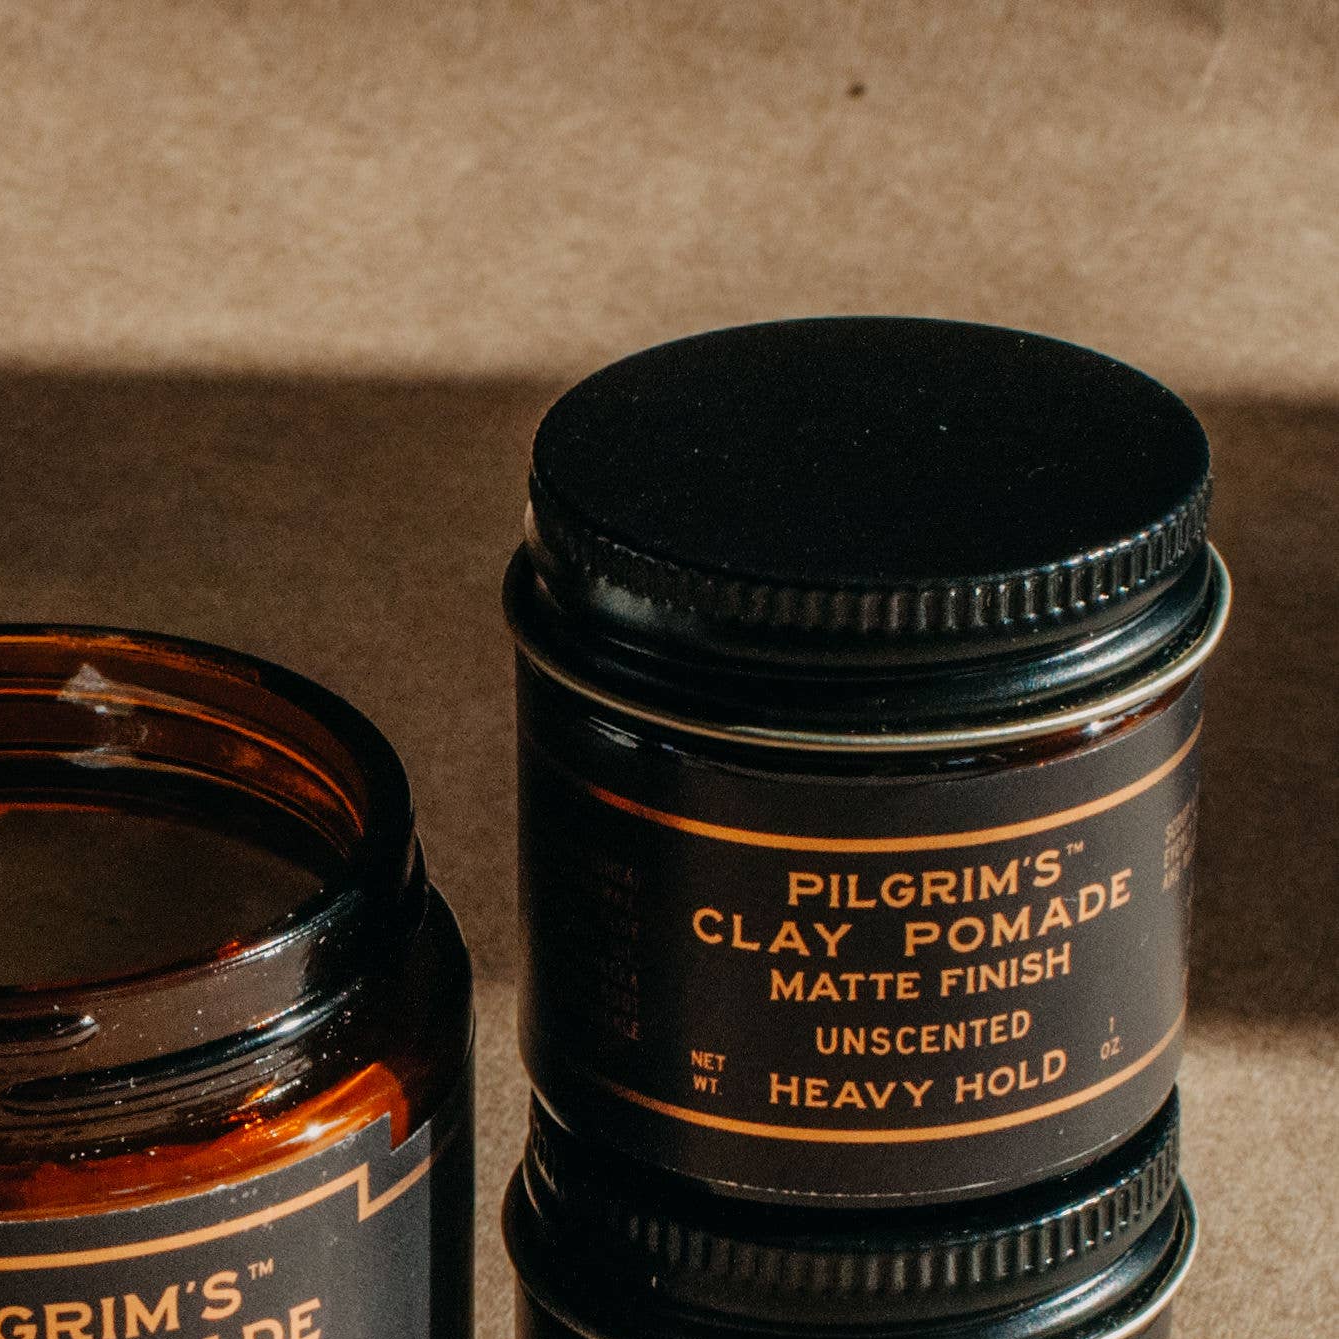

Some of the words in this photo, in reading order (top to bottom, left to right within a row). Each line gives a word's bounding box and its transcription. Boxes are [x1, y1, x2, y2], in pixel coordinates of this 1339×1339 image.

[692, 907, 852, 958] CLAY
[905, 867, 1134, 956] POMADE
[770, 968, 921, 1002] MATTE
[940, 941, 1072, 997] FINISH
[690, 1049, 726, 1072] NET
[816, 1009, 1032, 1056] UNSCENTED
[769, 1072, 934, 1110] HEAVY
[955, 1048, 1068, 1103] HOLD
